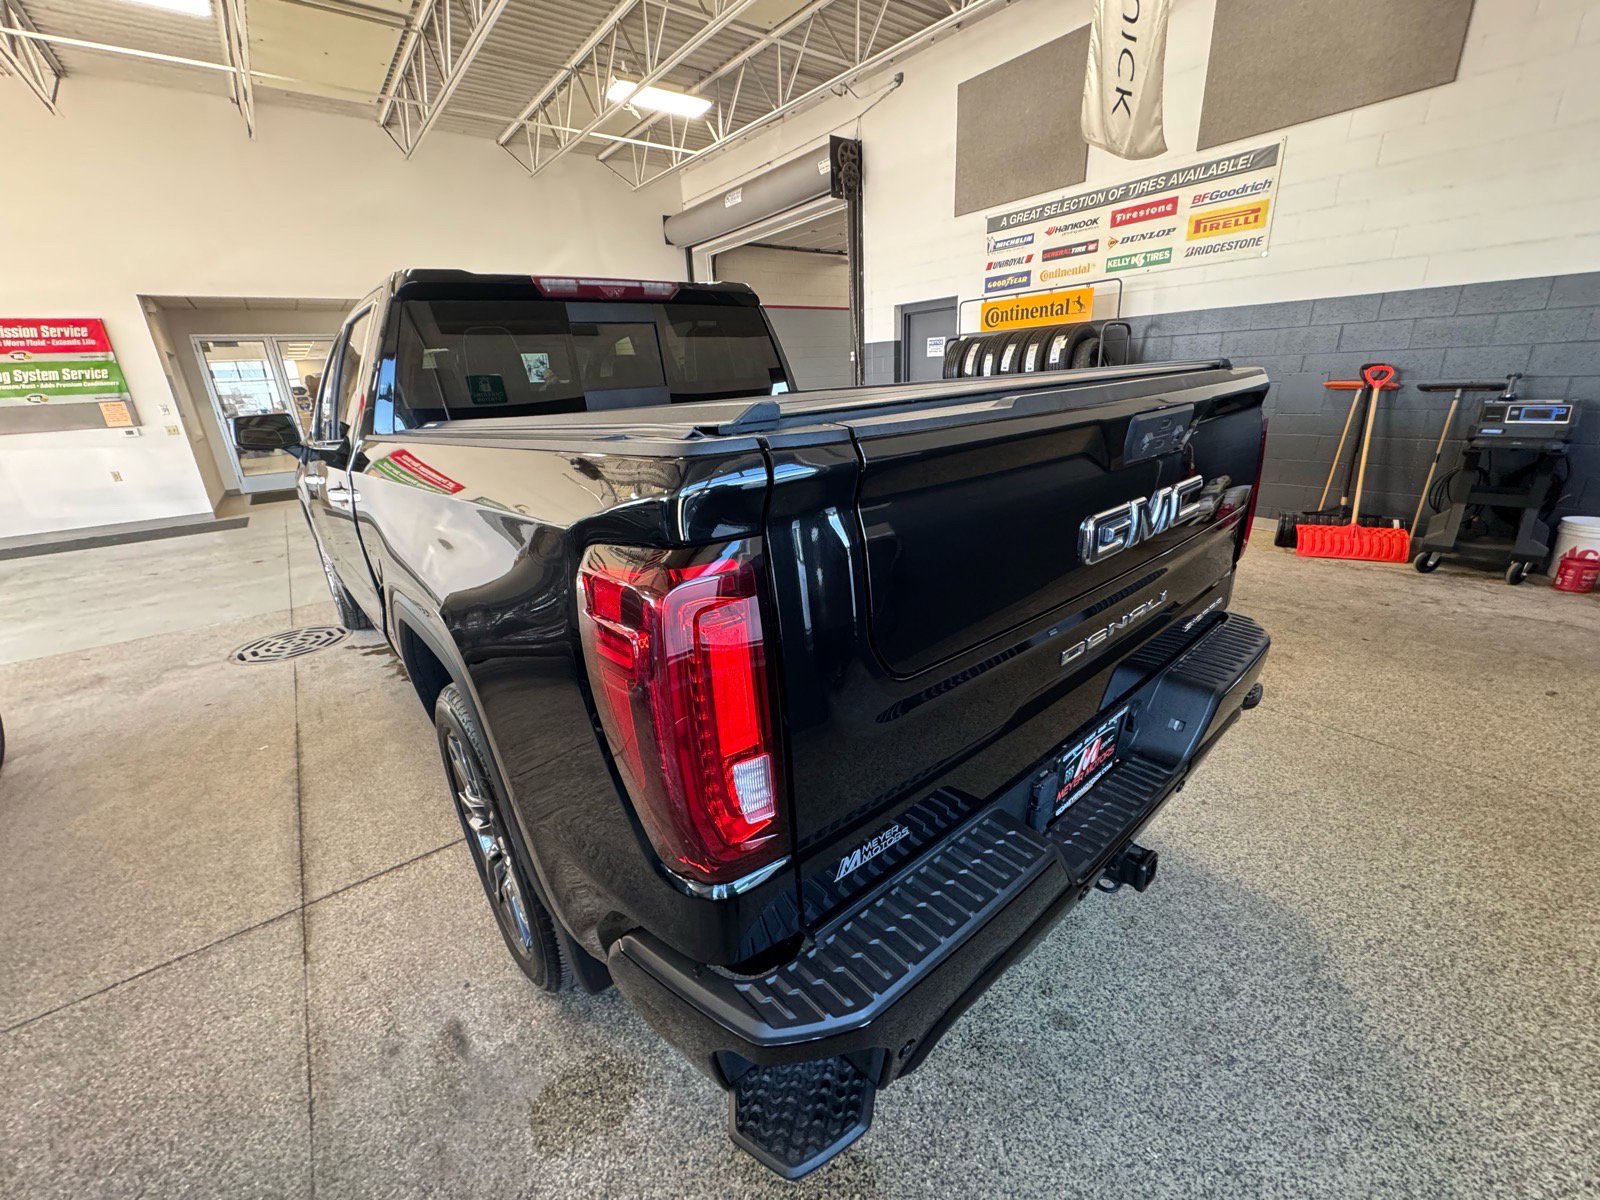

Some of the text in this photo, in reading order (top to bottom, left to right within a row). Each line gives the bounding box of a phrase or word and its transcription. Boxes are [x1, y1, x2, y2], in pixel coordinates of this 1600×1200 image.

[1000, 154, 1255, 228] A GREAT SELECTION OF TIRES AVAILABLE!
[1191, 178, 1273, 205] BFGoodrich
[1115, 203, 1174, 224] Firestone
[1193, 207, 1262, 234] PIRELLI
[995, 235, 1033, 248] MICHELIN
[1119, 227, 1177, 244] DUNLOP
[1184, 236, 1264, 258] BRIDGESTONE
[992, 256, 1026, 269] UNIROYAL
[1107, 250, 1170, 269] KELLY TIRES
[987, 276, 1028, 288] GOODYEAR
[1040, 263, 1091, 282] Continental
[984, 298, 1071, 328] Continental
[40, 325, 89, 338] Service
[13, 368, 60, 384] System
[62, 367, 109, 380] Service
[1078, 474, 1204, 566] GMC
[1060, 589, 1168, 666] DENALI
[862, 824, 899, 855] MEYER
[862, 826, 910, 864] MOTORS
